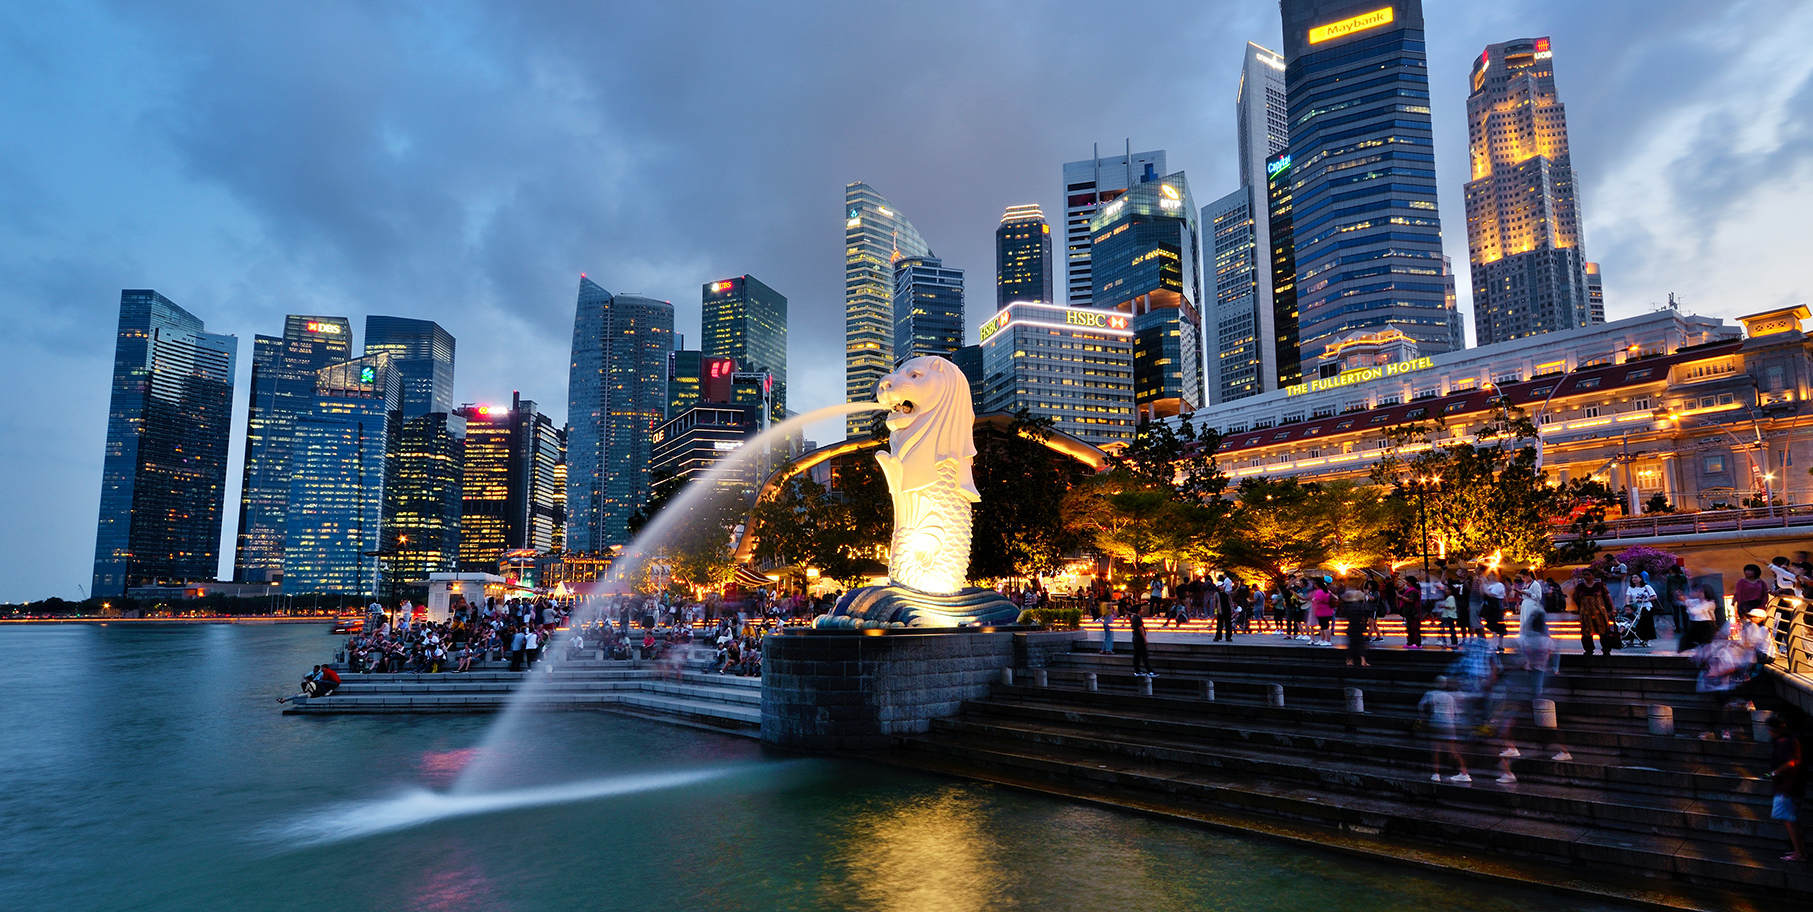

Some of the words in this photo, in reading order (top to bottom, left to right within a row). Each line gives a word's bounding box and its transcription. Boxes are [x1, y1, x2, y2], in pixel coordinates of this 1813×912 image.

[1327, 13, 1384, 35] Maybank
[1533, 51, 1553, 60] UOB
[719, 281, 732, 290] UBS
[1066, 310, 1106, 328] HSBC
[318, 323, 341, 335] DBS
[979, 317, 999, 342] HSBC
[1285, 384, 1308, 397] THE
[1311, 367, 1382, 392] FULLERTON
[1386, 356, 1434, 376] HOTEL
